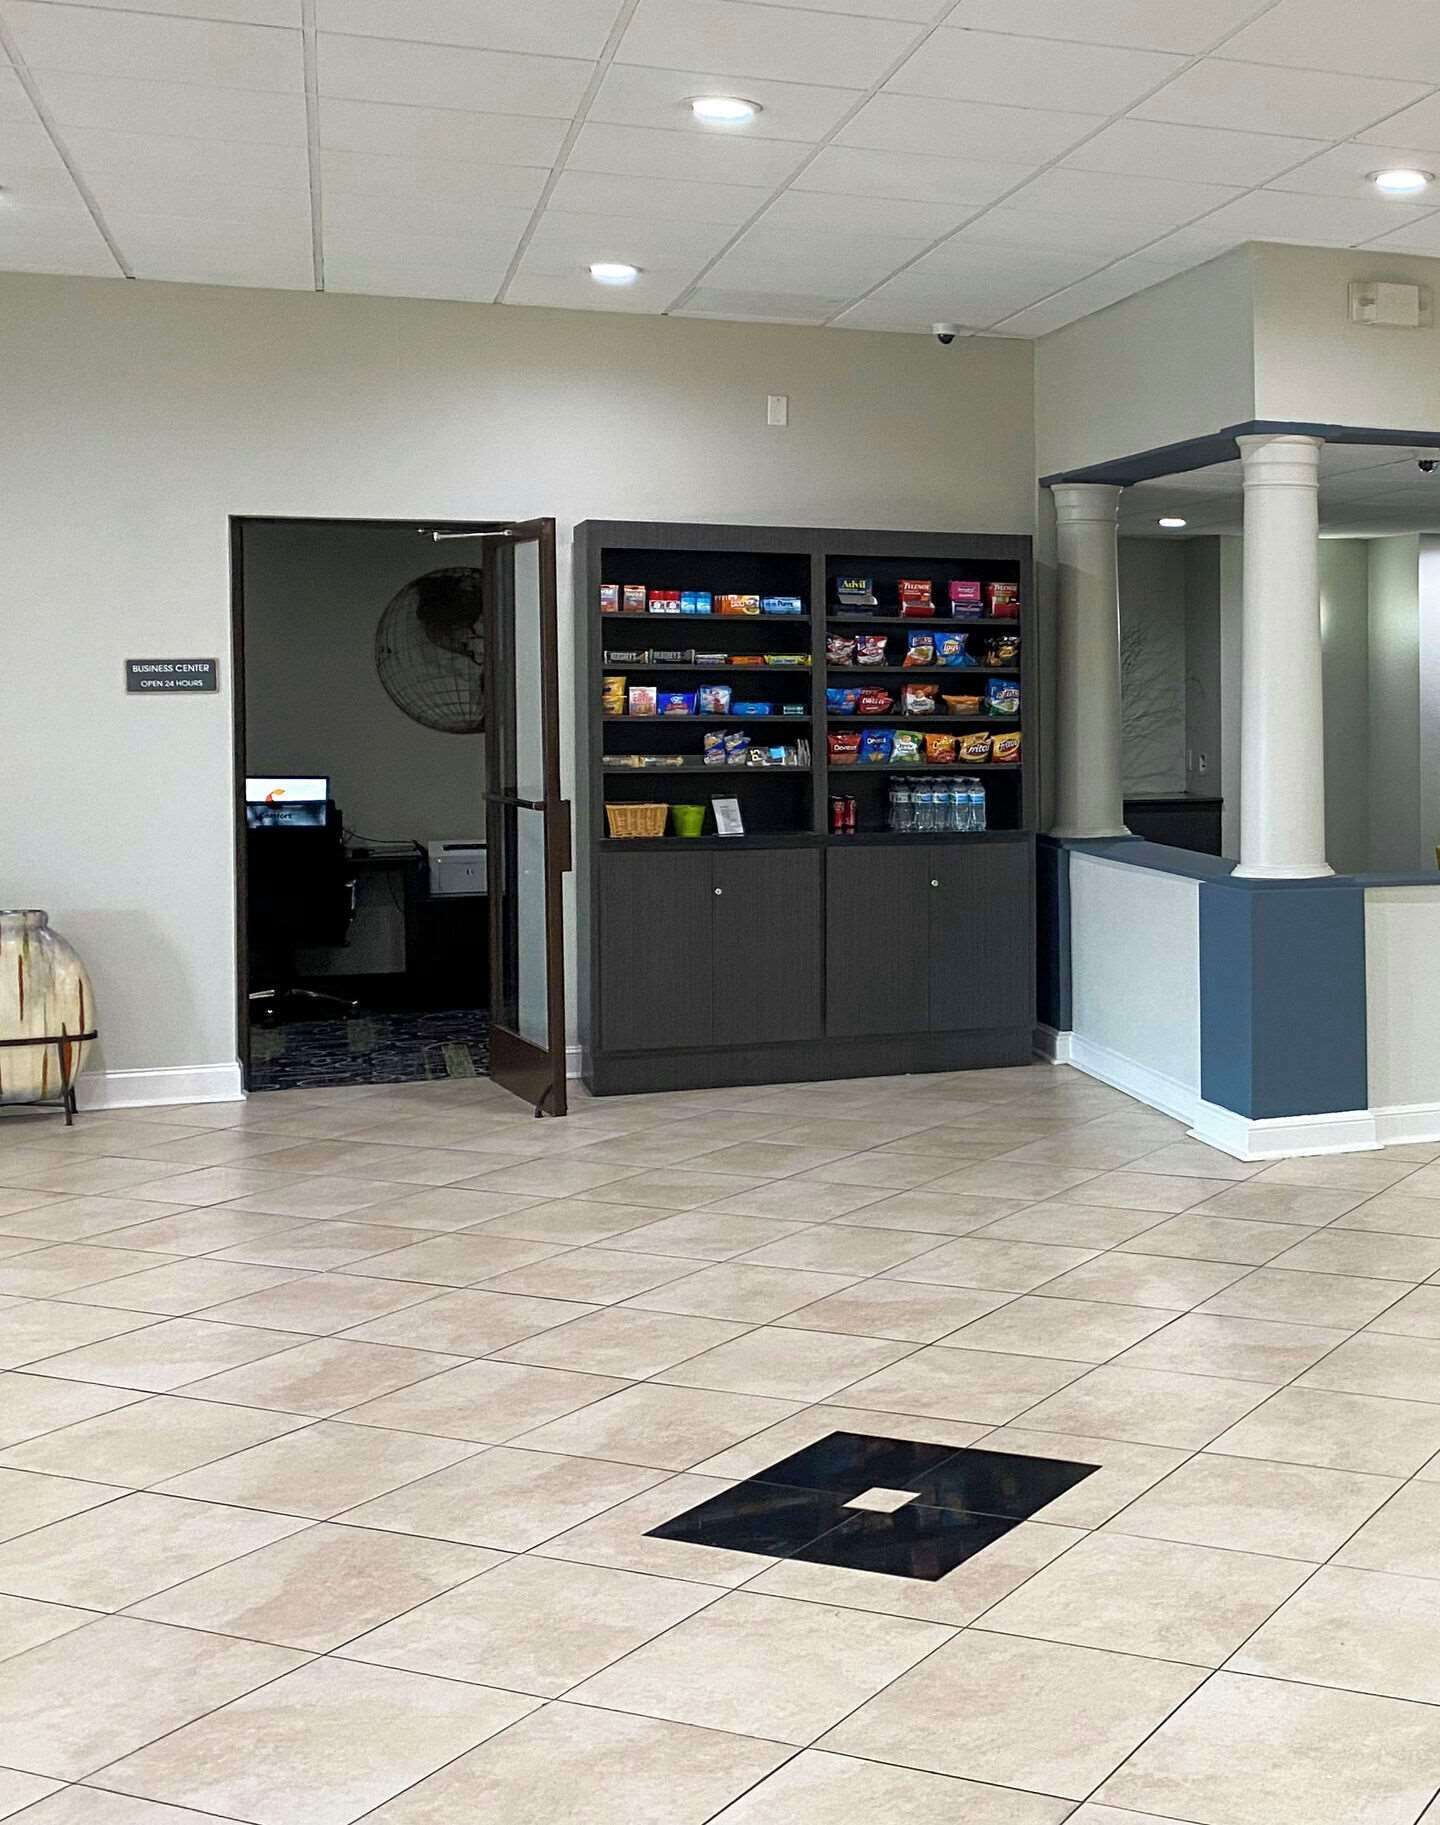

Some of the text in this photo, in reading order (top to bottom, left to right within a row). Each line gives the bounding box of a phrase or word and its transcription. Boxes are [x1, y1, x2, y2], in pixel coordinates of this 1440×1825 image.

[842, 580, 866, 589] Advil
[132, 663, 210, 673] BUSINESS CENTER
[140, 679, 203, 688] OPEN 24 HOURS
